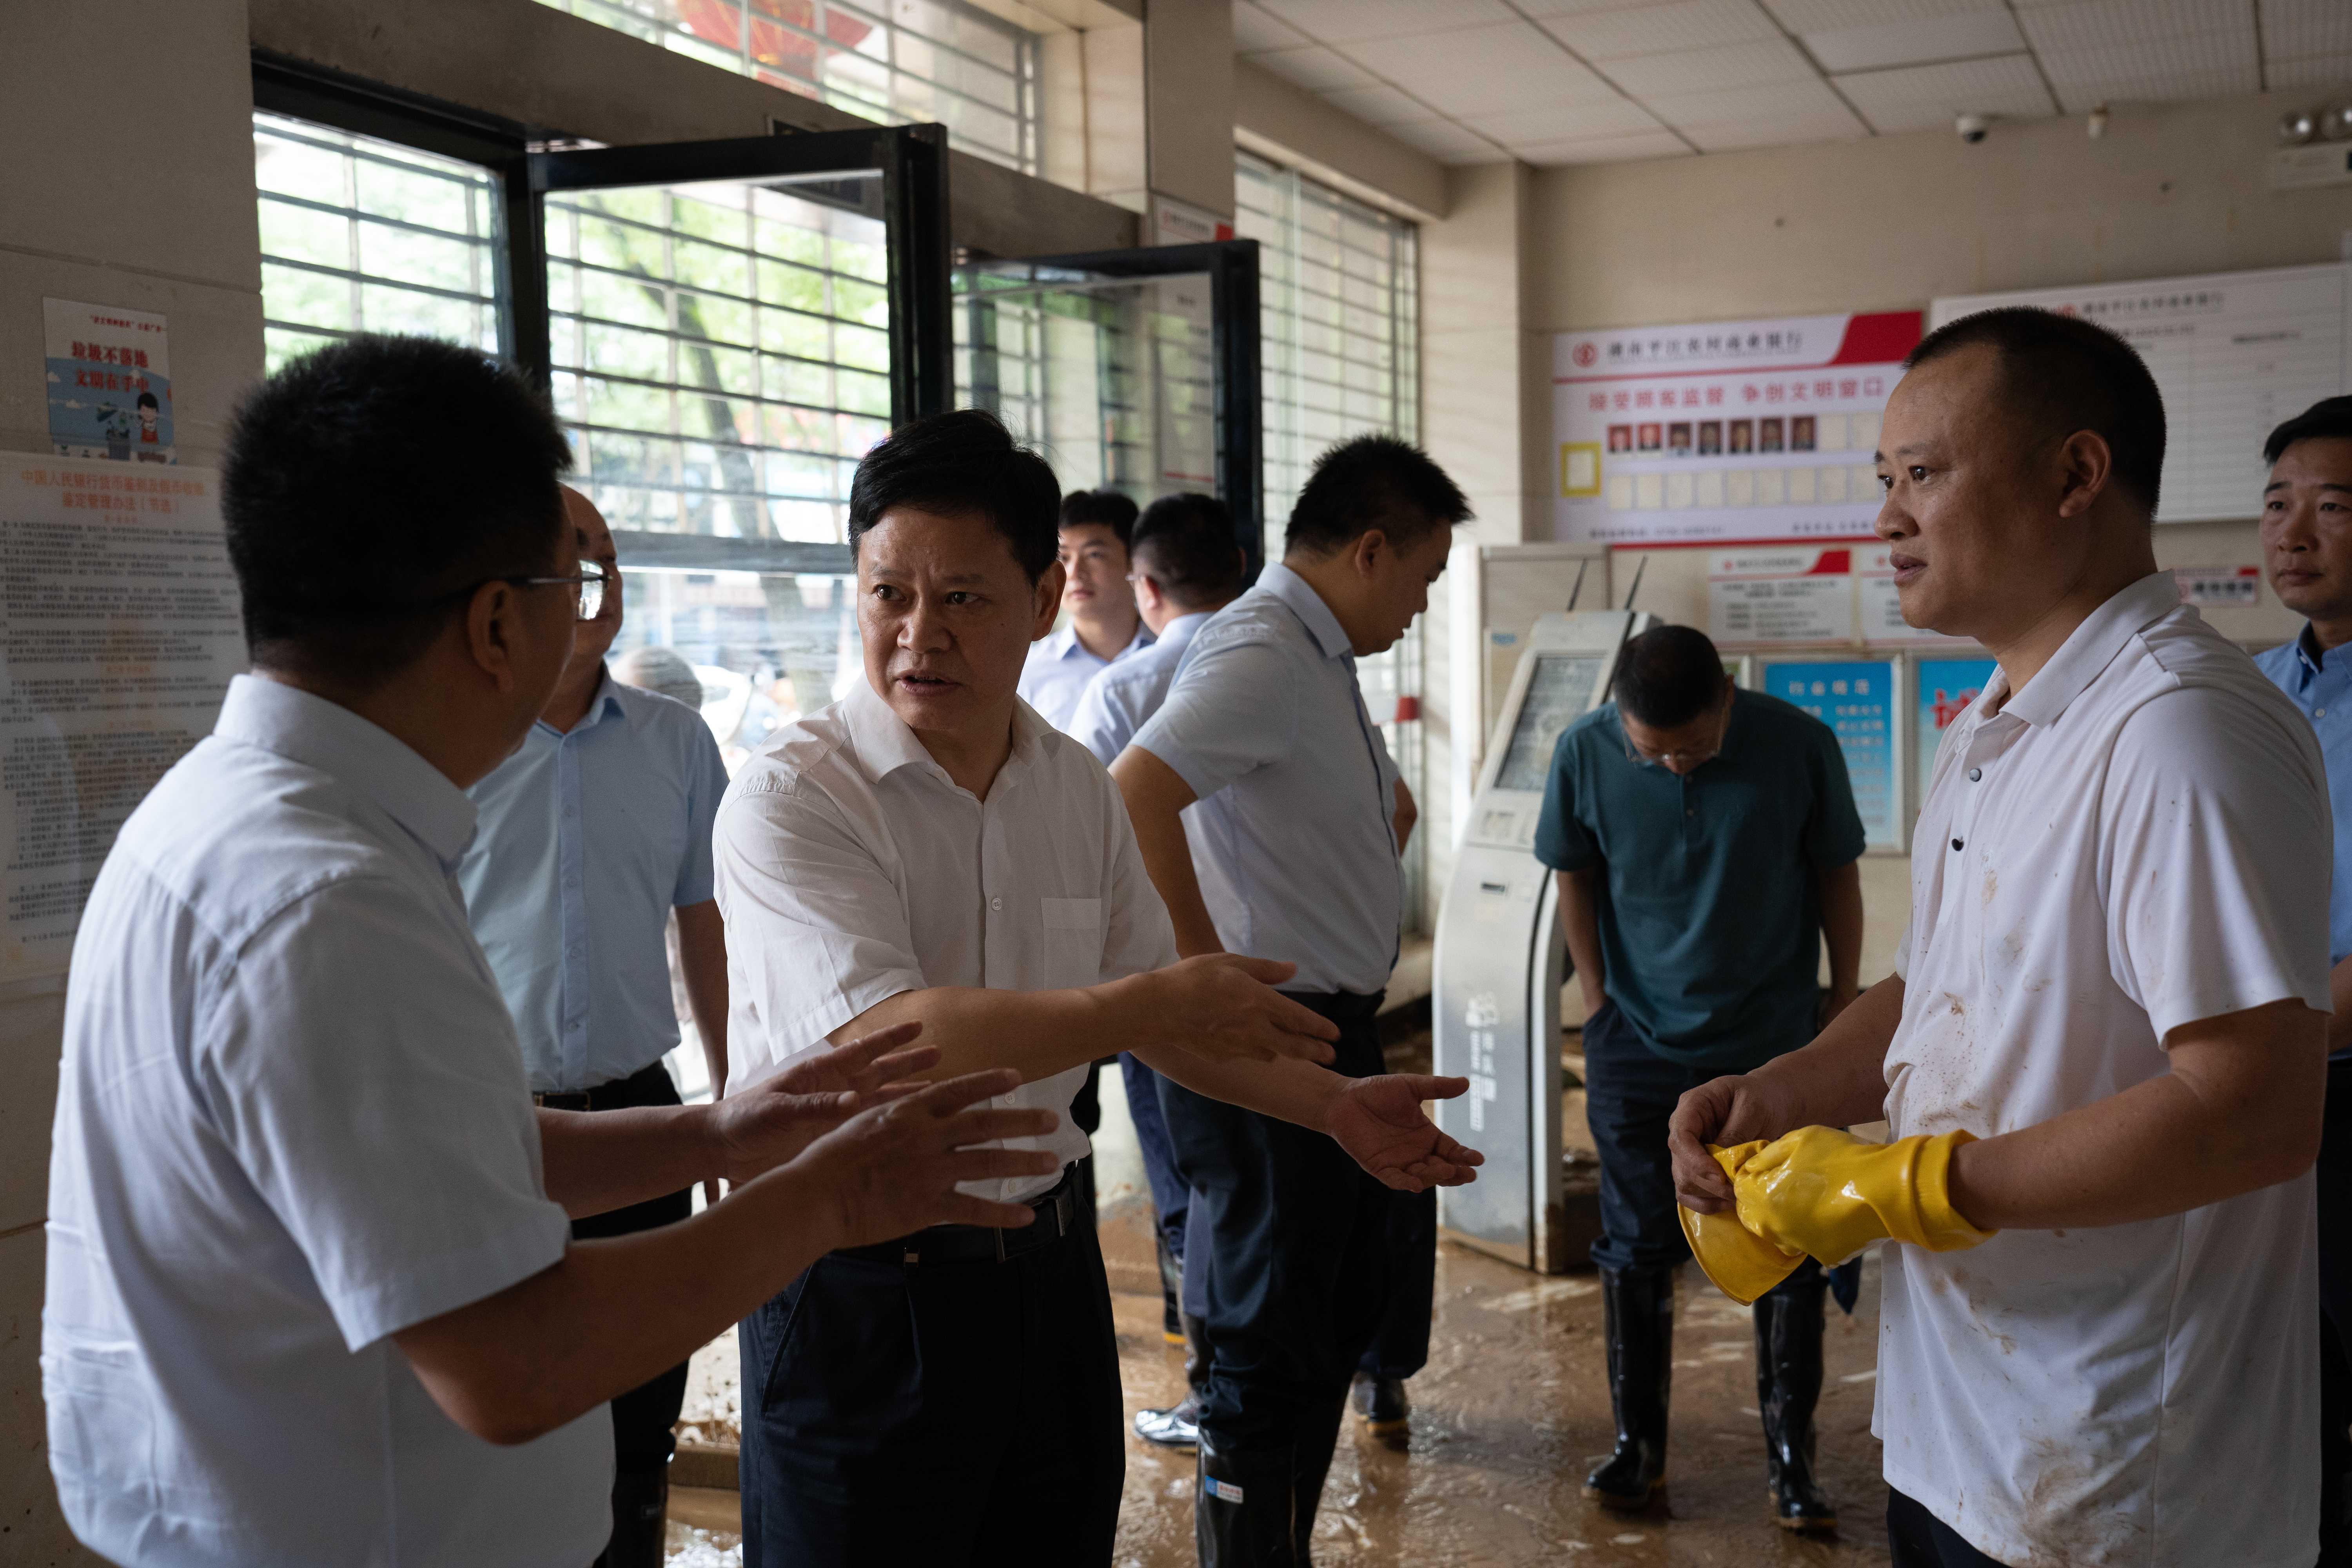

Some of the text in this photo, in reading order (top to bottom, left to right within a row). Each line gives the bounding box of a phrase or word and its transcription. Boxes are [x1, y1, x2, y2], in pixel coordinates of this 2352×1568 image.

[72, 341, 149, 368] 垃圾不落地
[75, 367, 149, 394] 文明在手中
[1589, 376, 1883, 412] 接受顾客监督 争创文明窗口
